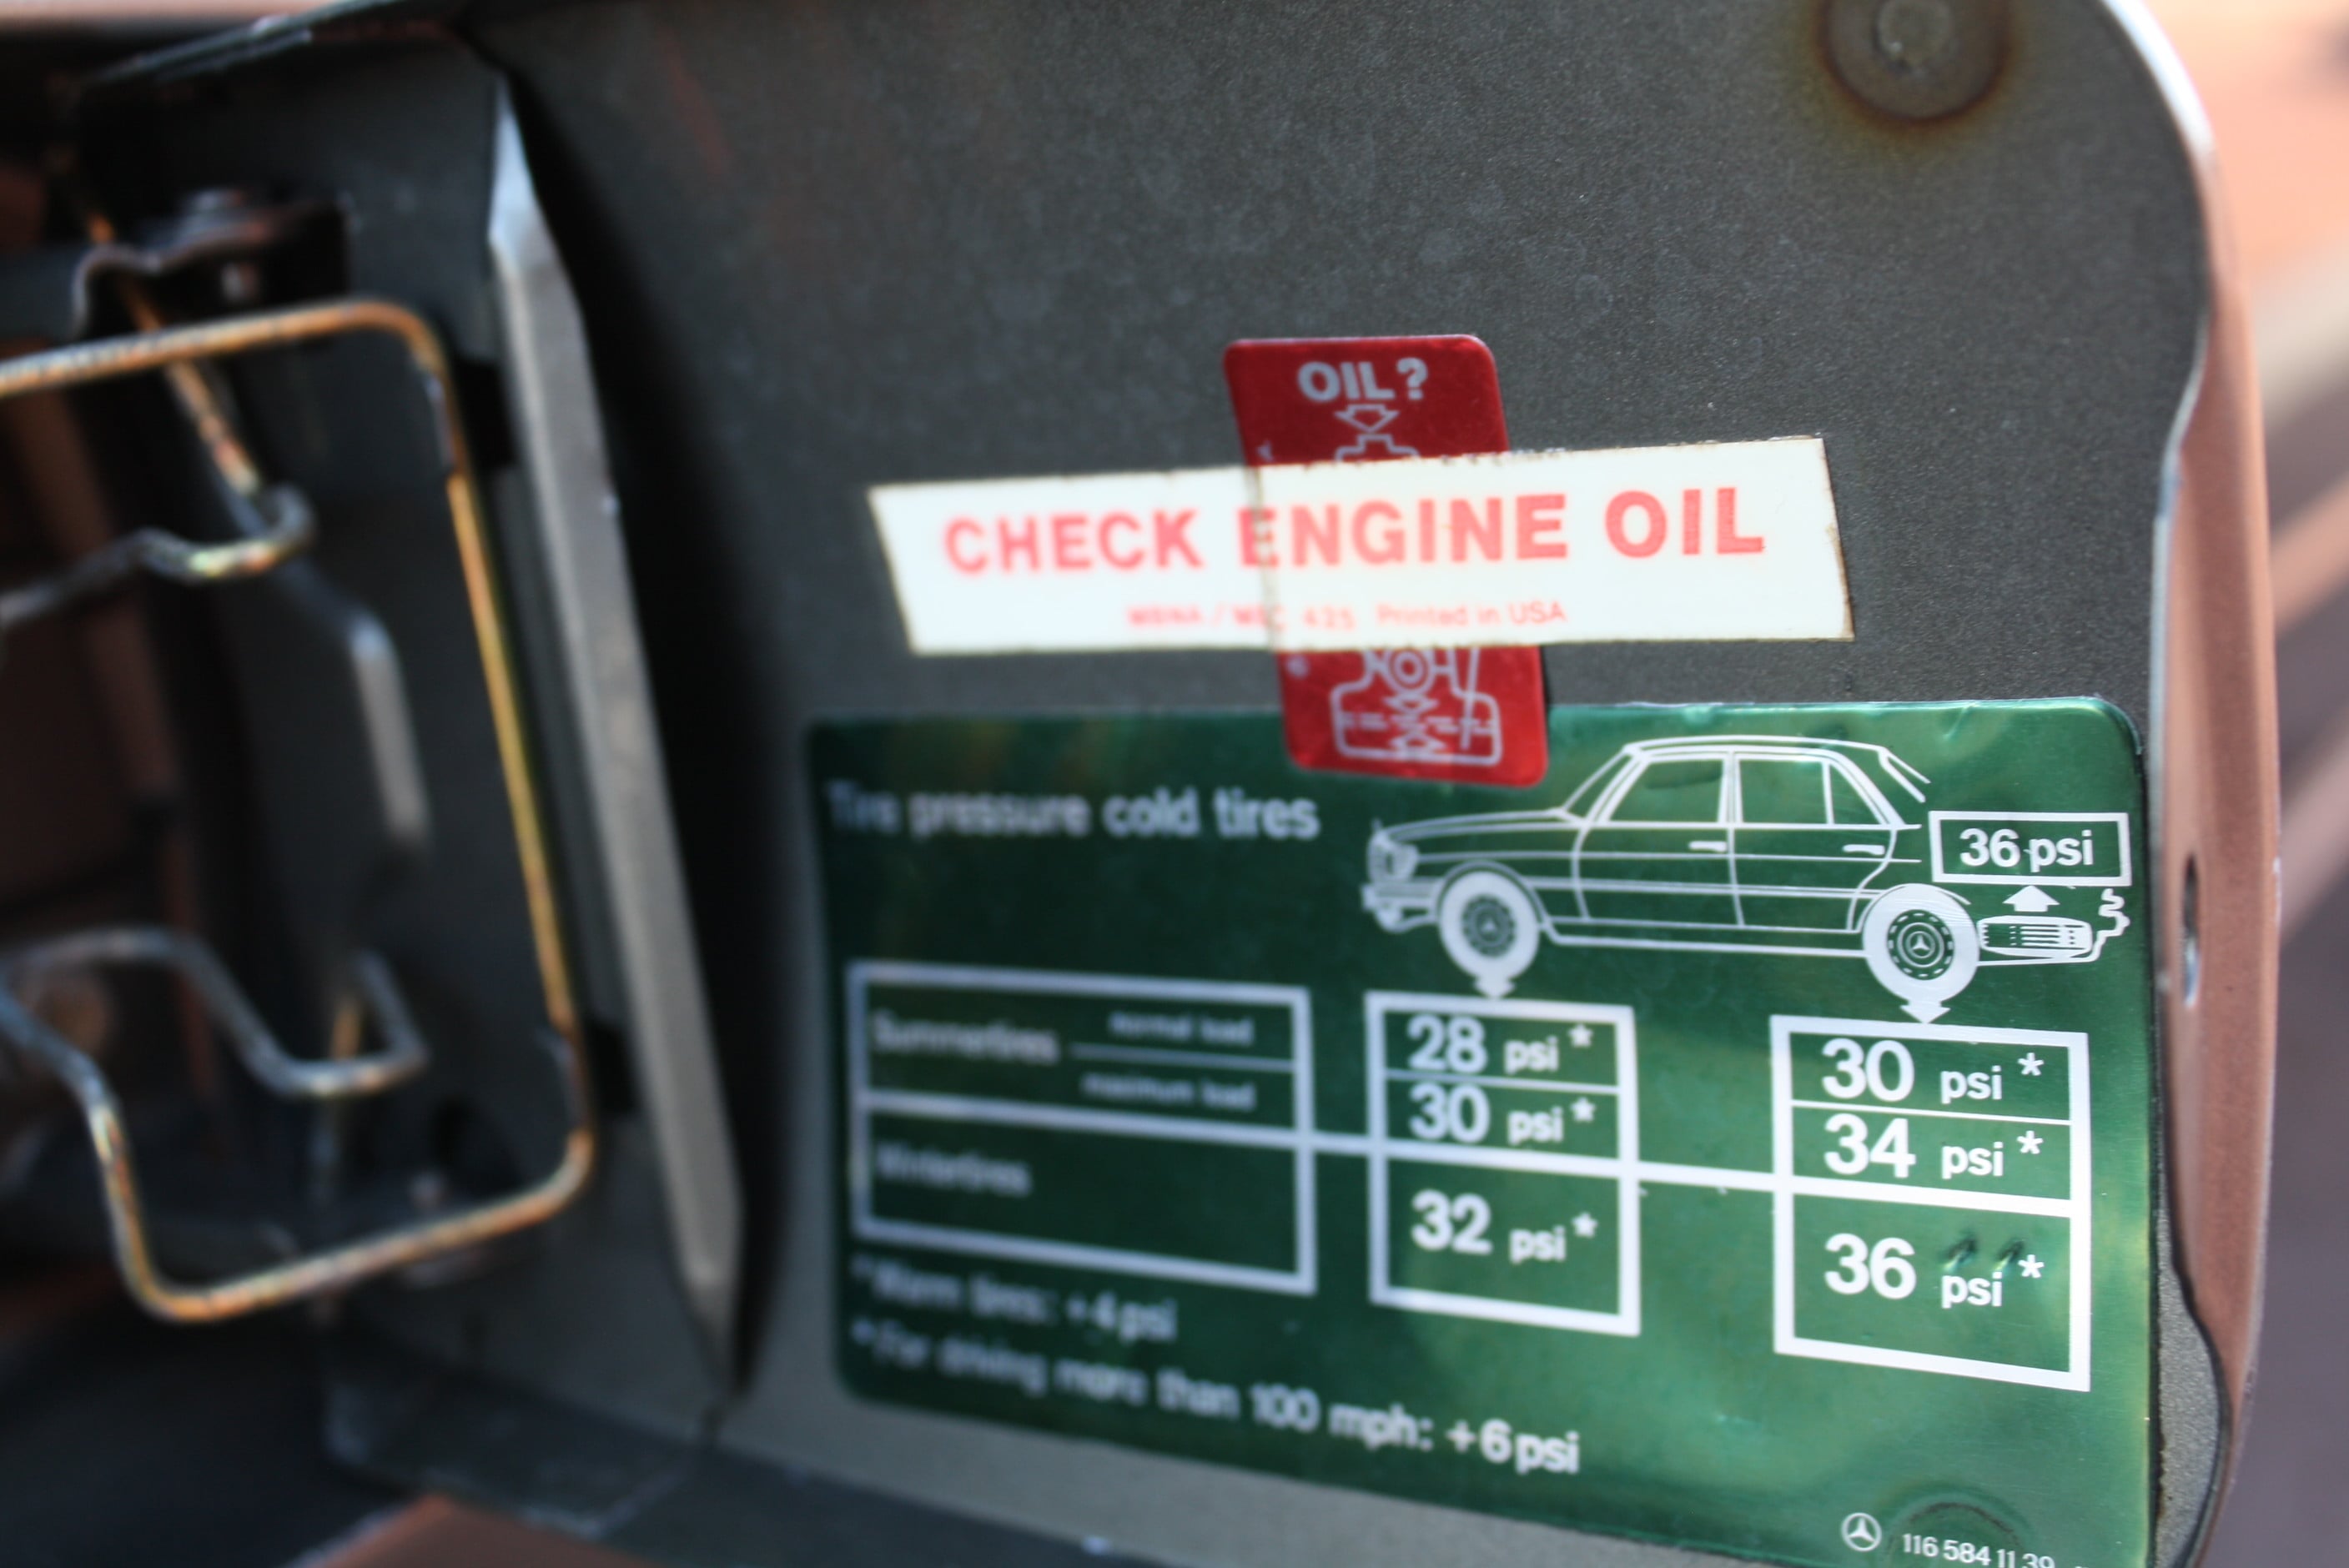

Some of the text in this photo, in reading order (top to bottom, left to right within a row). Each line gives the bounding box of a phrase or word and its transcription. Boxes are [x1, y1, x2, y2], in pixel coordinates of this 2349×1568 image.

[944, 487, 1764, 574] CHECK ENGINE OIL
[1376, 603, 1467, 626] Printed
[1477, 605, 1501, 625] in
[1509, 601, 1567, 624] USA
[908, 792, 1091, 841] pressure
[1103, 787, 1200, 837] cold
[1213, 787, 1320, 839] tires
[1960, 828, 2094, 872] 36 psi
[1407, 1014, 1487, 1073] 28
[1822, 1038, 1914, 1102] 30
[1410, 1083, 1490, 1143] 30
[1824, 1113, 1916, 1179] 34
[1411, 1189, 1492, 1254] 32
[1824, 1233, 1916, 1299] 36
[1054, 1357, 1148, 1406] more
[1156, 1365, 1240, 1416] than
[1250, 1383, 1320, 1433] 100
[1329, 1402, 1433, 1450] mph:
[1903, 1533, 1939, 1558] 116
[1944, 1539, 1991, 1565] 584
[1997, 1549, 2015, 1568] 11
